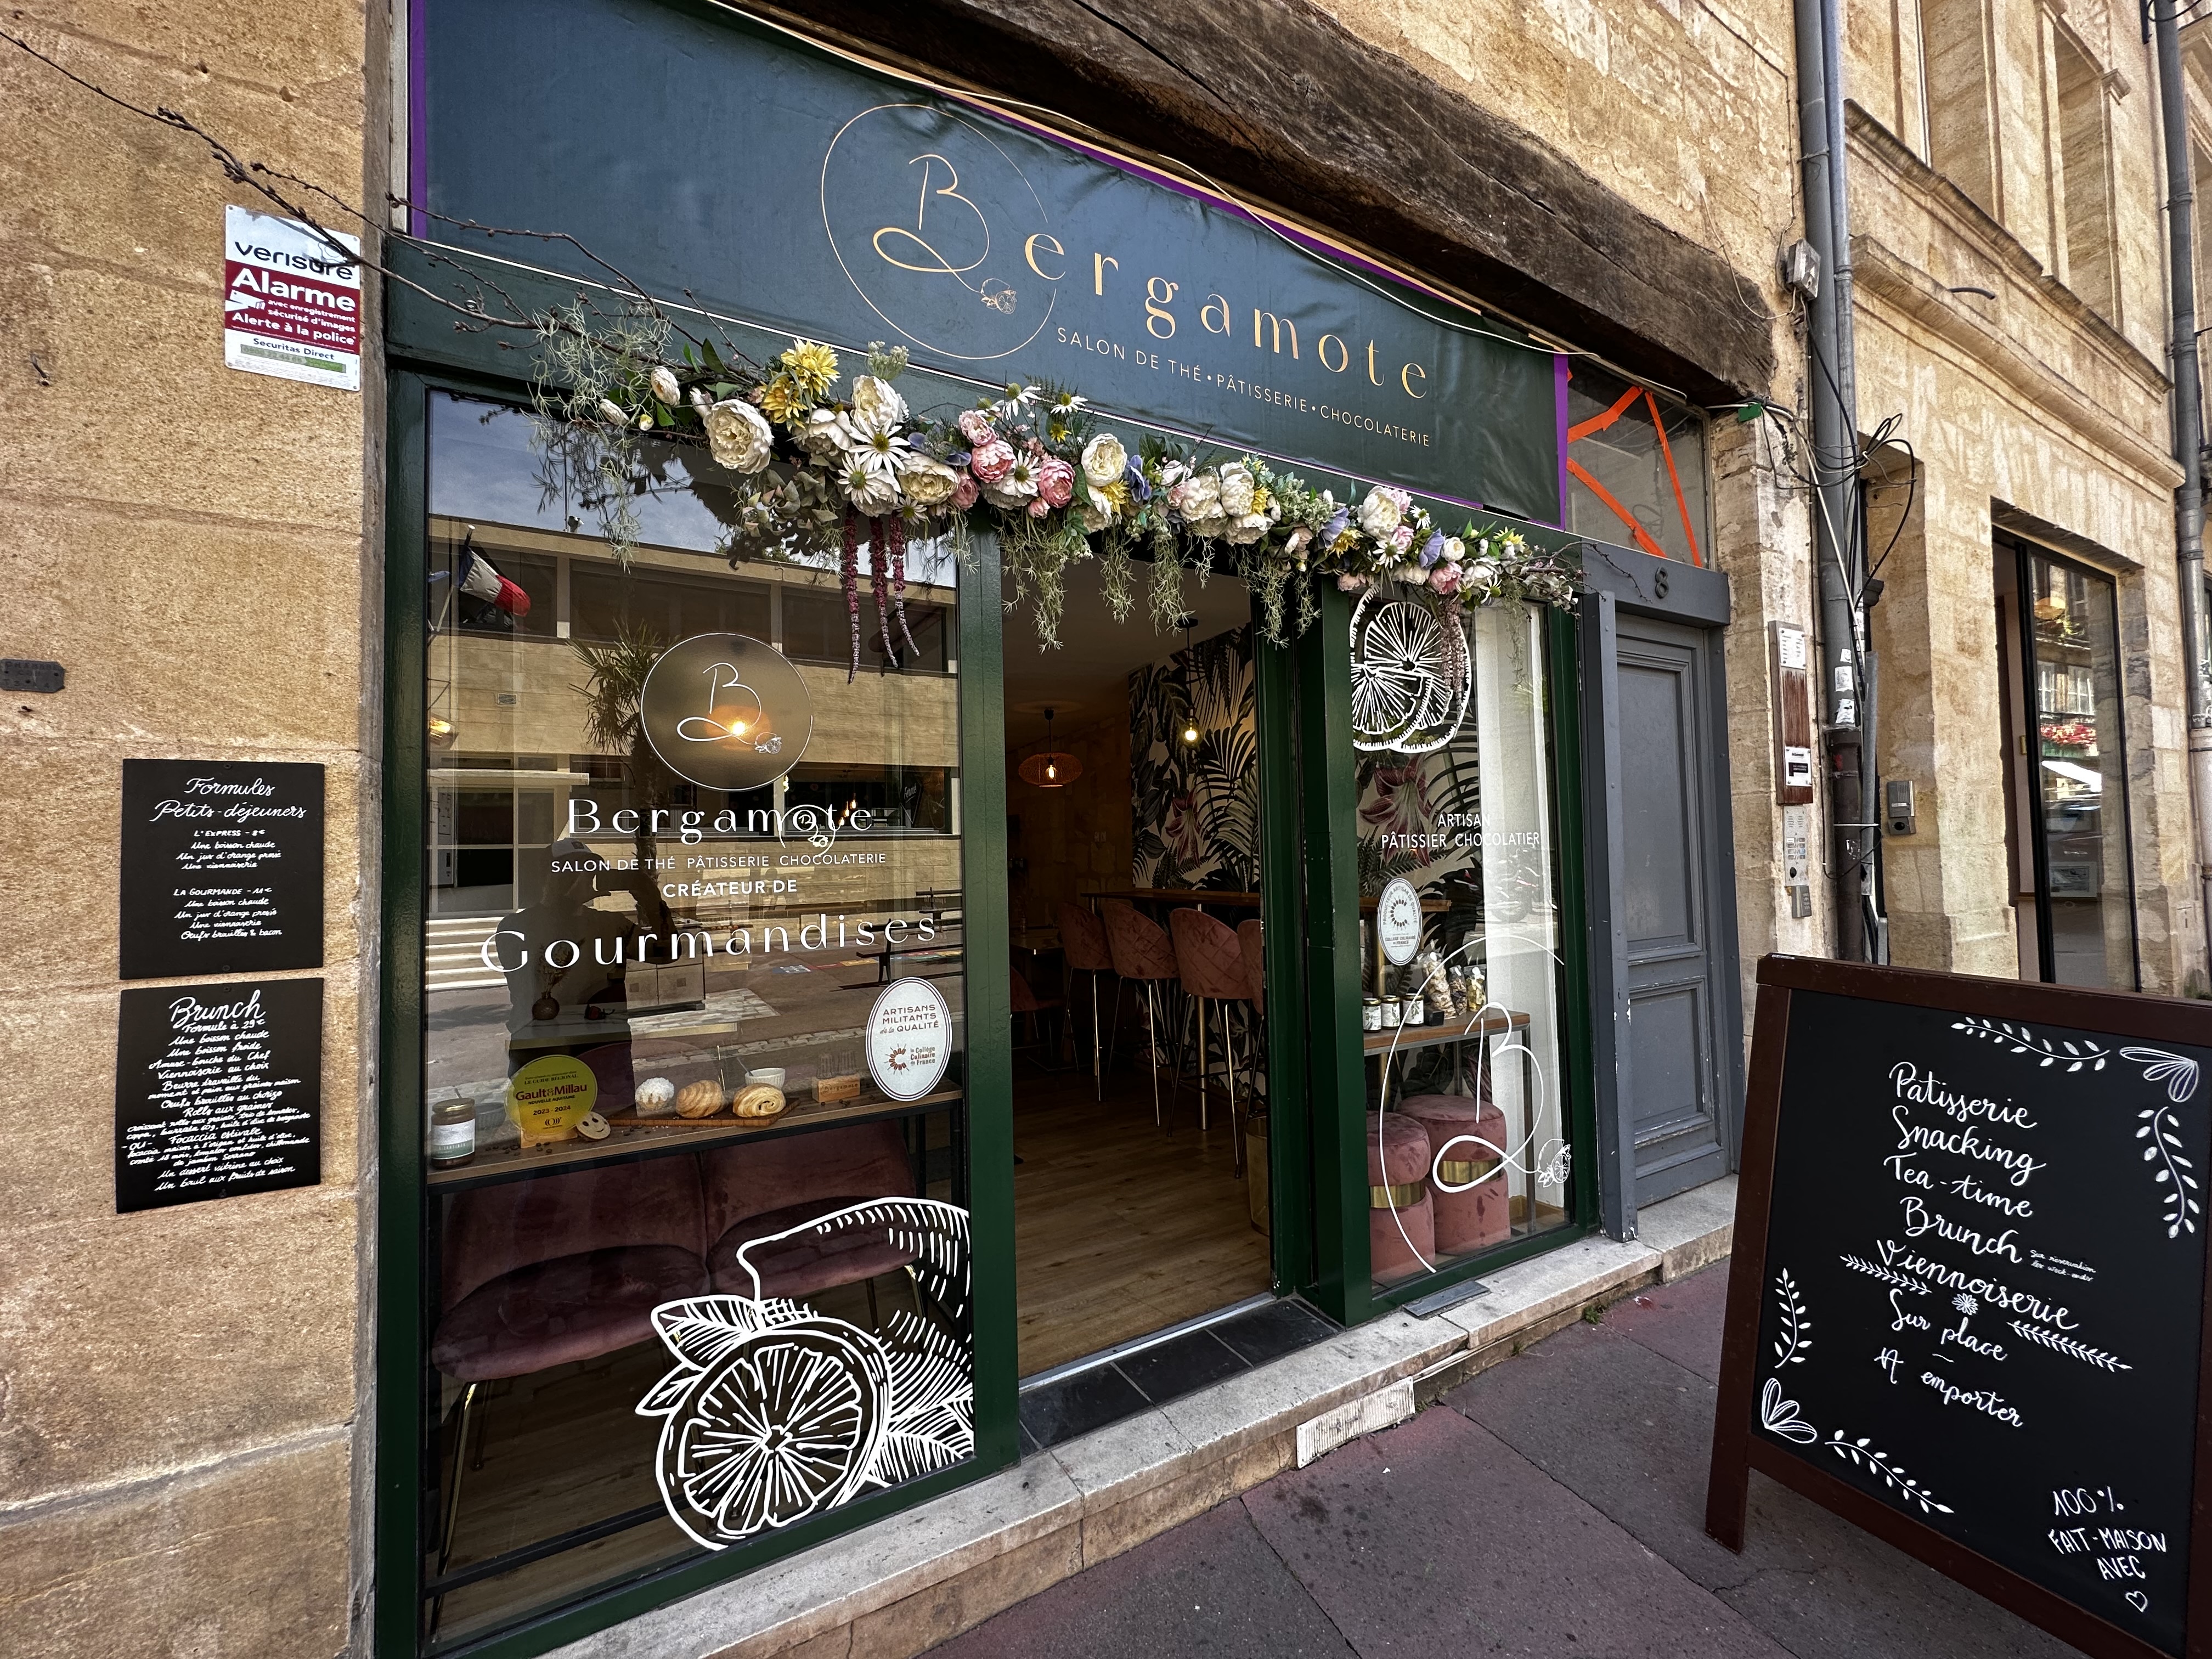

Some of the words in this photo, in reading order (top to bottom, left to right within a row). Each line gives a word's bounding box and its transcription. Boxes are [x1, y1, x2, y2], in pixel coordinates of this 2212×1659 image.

[232, 267, 356, 312] Alarme
[267, 308, 310, 323] sécurisé
[311, 315, 356, 333] d'images
[268, 299, 288, 309] avec
[290, 303, 356, 323] enregistrement
[232, 312, 280, 330] Alerte
[284, 322, 293, 333] à
[297, 324, 309, 336] la
[253, 338, 301, 353] Securitas
[303, 348, 335, 360] Direct
[1057, 326, 1125, 360] SALON
[1136, 349, 1159, 370] DE
[1167, 359, 1201, 381] THÉ
[1216, 373, 1307, 413] PÂTISSERIE
[1319, 404, 1430, 447] CHOCOLATERIE
[1655, 566, 1669, 599] 8
[184, 777, 275, 797] Formules
[567, 798, 873, 845] Bergamote
[1437, 813, 1491, 827] ARTISAN
[1381, 831, 1447, 849] PÂTISSIER
[1455, 832, 1541, 847] CHOCOLATIER
[551, 860, 611, 873] SALON
[617, 859, 639, 871] DE
[645, 855, 676, 870] THÉ
[687, 854, 770, 868] PÂTISSERIE
[779, 853, 887, 866] CHOCOLATERIE
[189, 888, 243, 896] GOURMANDE
[662, 879, 766, 898] CRÉATEUR
[772, 879, 798, 894] DE
[238, 897, 269, 905] chaude
[479, 913, 936, 974] Gourmandises
[168, 989, 266, 1029] Brunch
[882, 1013, 936, 1025] MILITANTS
[883, 1004, 936, 1016] ARTISANS
[182, 1020, 228, 1033] Formule
[896, 1020, 939, 1032] QUALITÉ
[168, 1036, 196, 1046] Une
[199, 1033, 231, 1044] boisson
[234, 1030, 270, 1041] chaude
[166, 1048, 191, 1058] Une
[195, 1046, 228, 1056] boisson
[227, 1054, 242, 1063] du
[247, 1050, 272, 1060] Chef
[910, 1052, 935, 1060] Culinaire
[168, 1132, 217, 1145] Focaccia
[1891, 1104, 2048, 1187] Snacking
[1899, 1197, 2023, 1264] Brunch
[1876, 1238, 2079, 1330] Viennoiserie
[1890, 1288, 1931, 1332] Sur
[1940, 1317, 2008, 1362] place
[1921, 1370, 2024, 1428] emporter
[2096, 1555, 2146, 1581] AVEC
